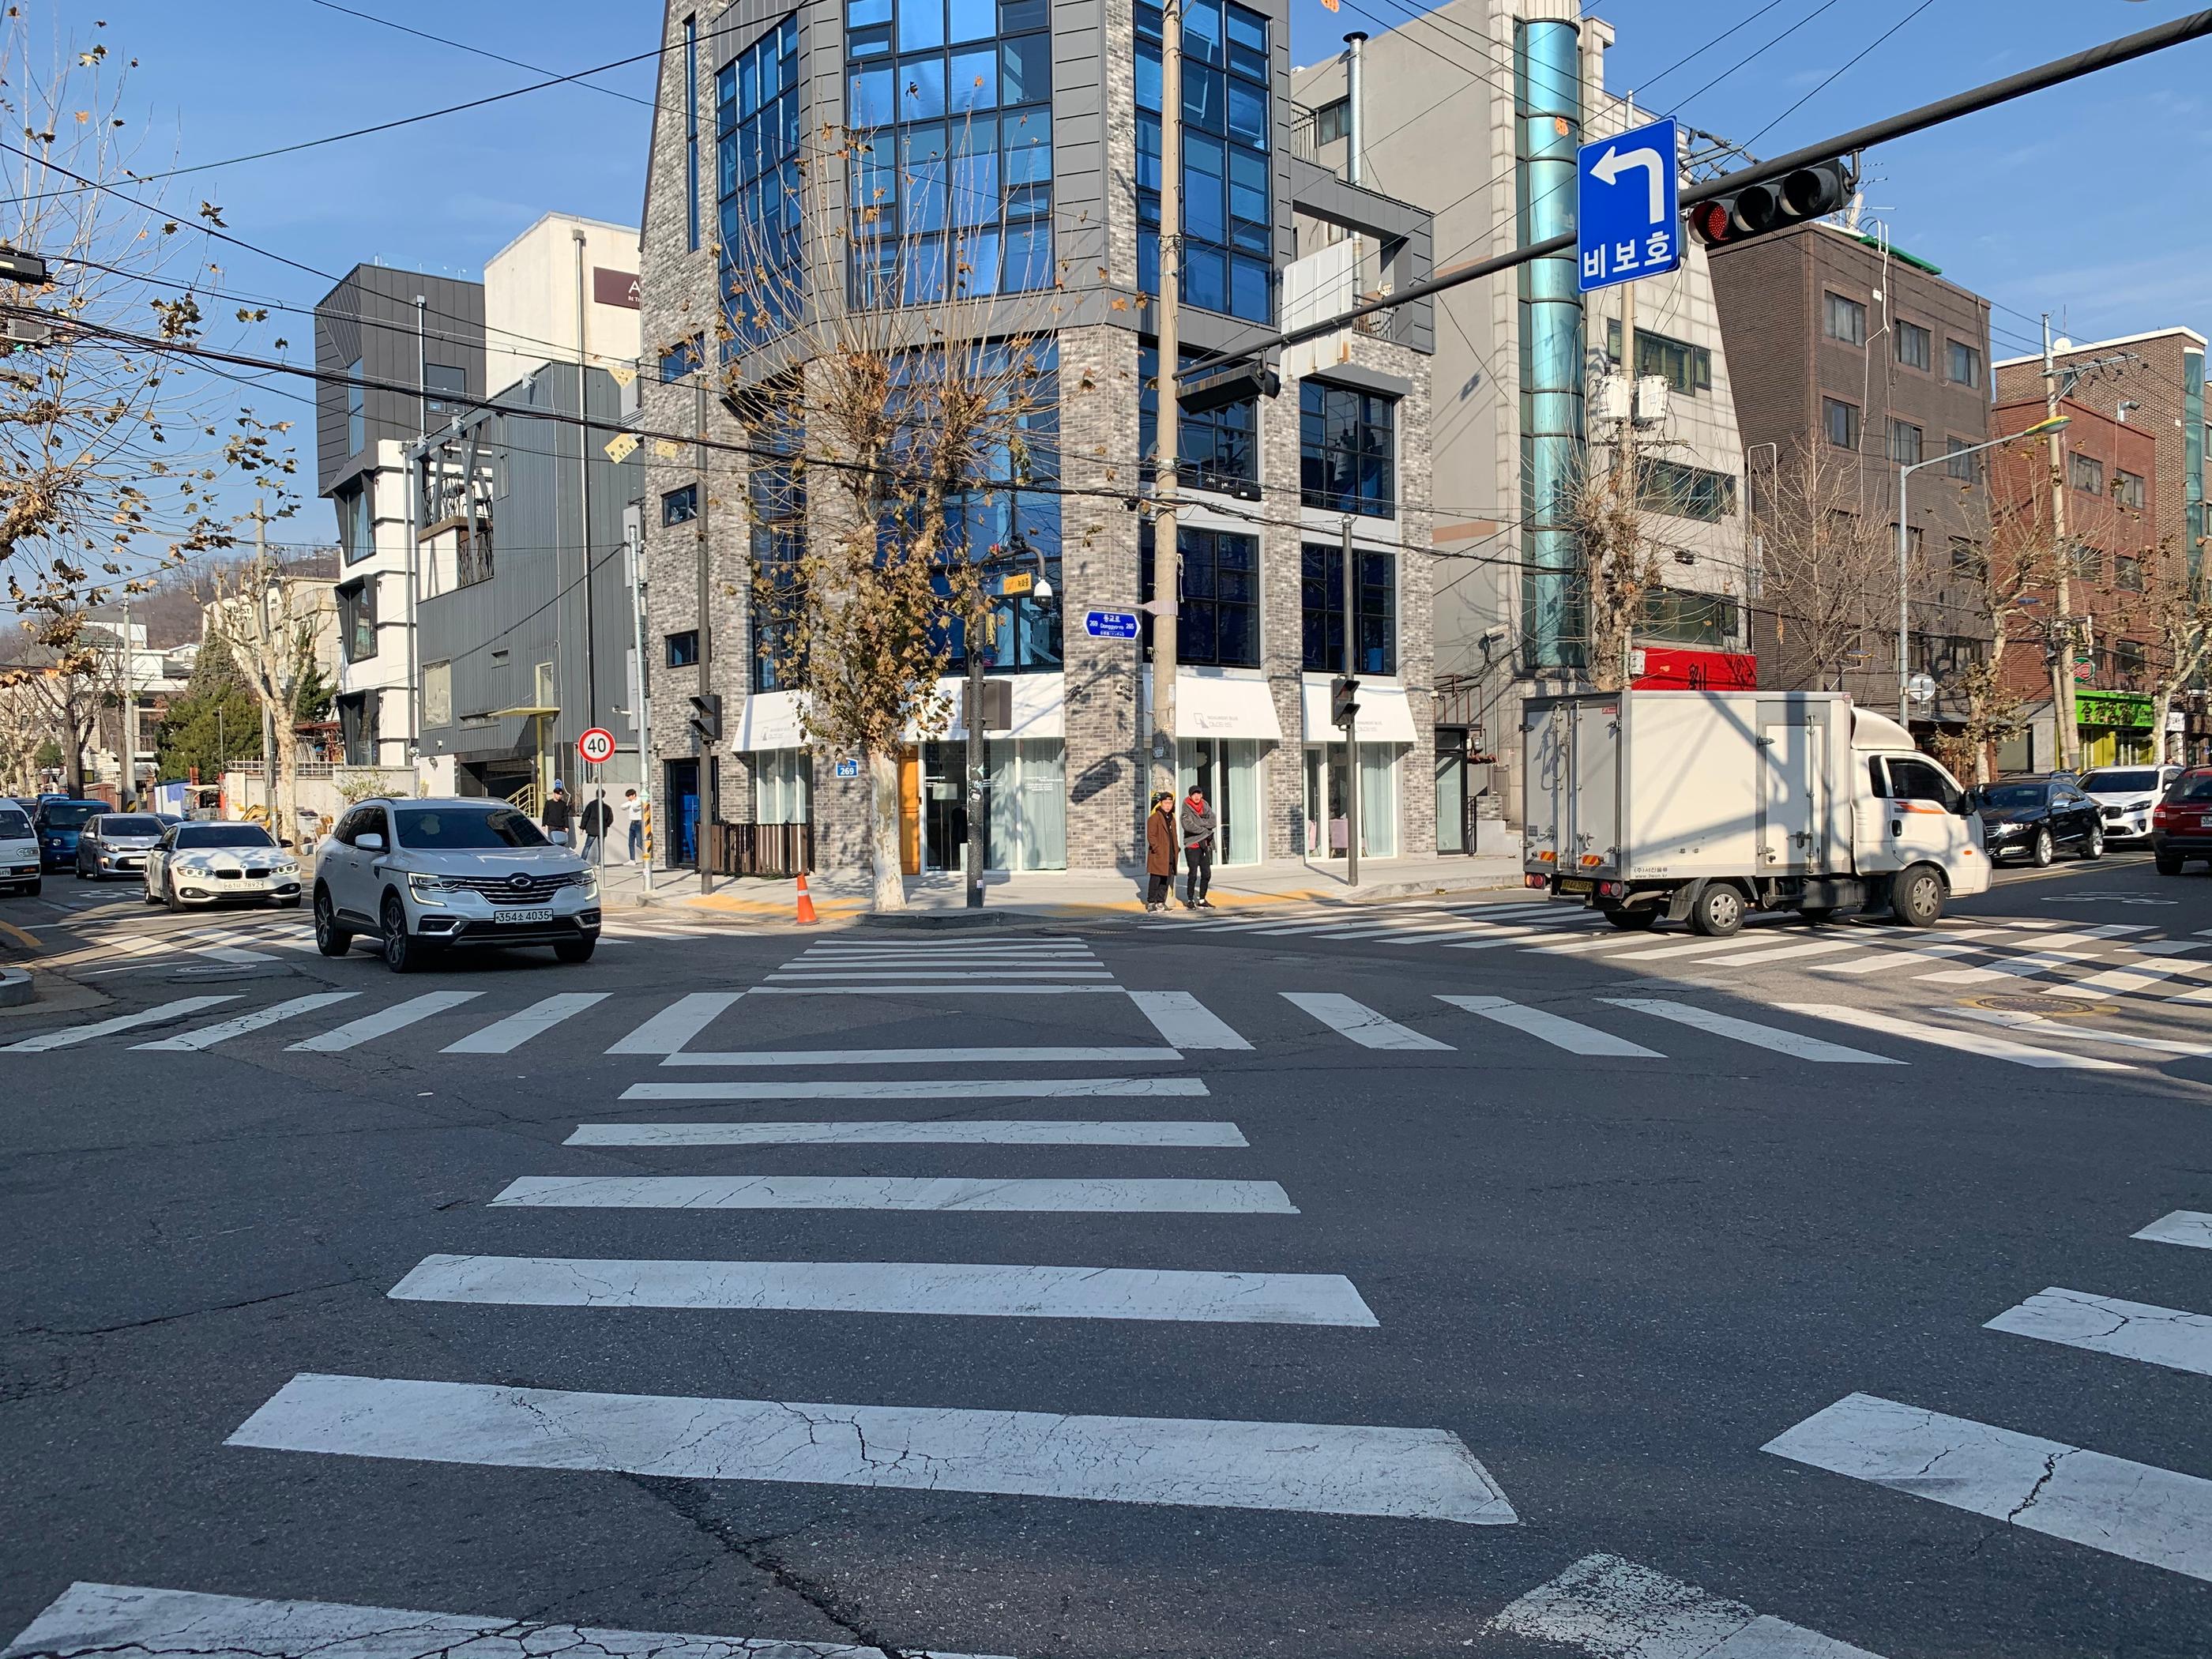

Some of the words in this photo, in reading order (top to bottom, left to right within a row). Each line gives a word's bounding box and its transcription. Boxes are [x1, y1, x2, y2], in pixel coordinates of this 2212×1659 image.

[1583, 230, 1672, 279] 비보호
[1104, 614, 1121, 623] 동교로
[587, 738, 607, 753] 40
[840, 767, 855, 776] 269
[498, 912, 524, 922] 354소
[525, 911, 550, 920] 4035
